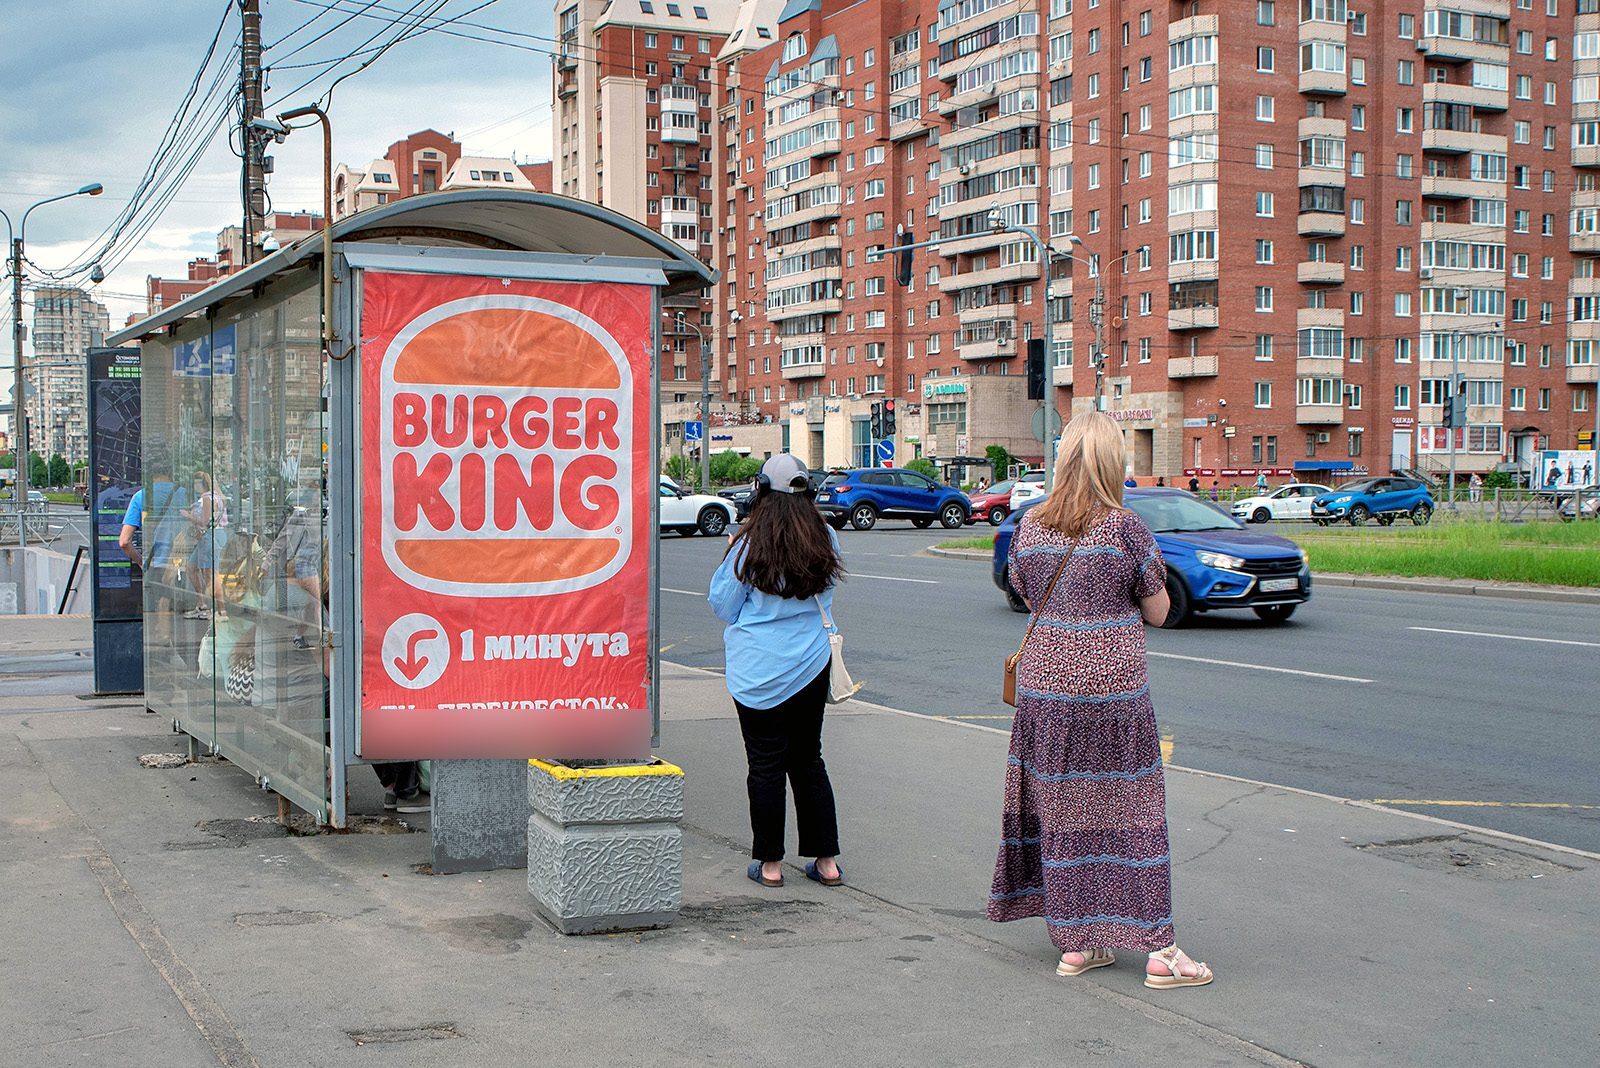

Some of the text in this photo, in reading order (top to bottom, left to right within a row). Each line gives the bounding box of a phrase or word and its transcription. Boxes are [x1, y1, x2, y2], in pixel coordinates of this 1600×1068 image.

[392, 392, 620, 451] BURGER
[392, 451, 619, 532] KING
[460, 629, 629, 667] 1 минута
